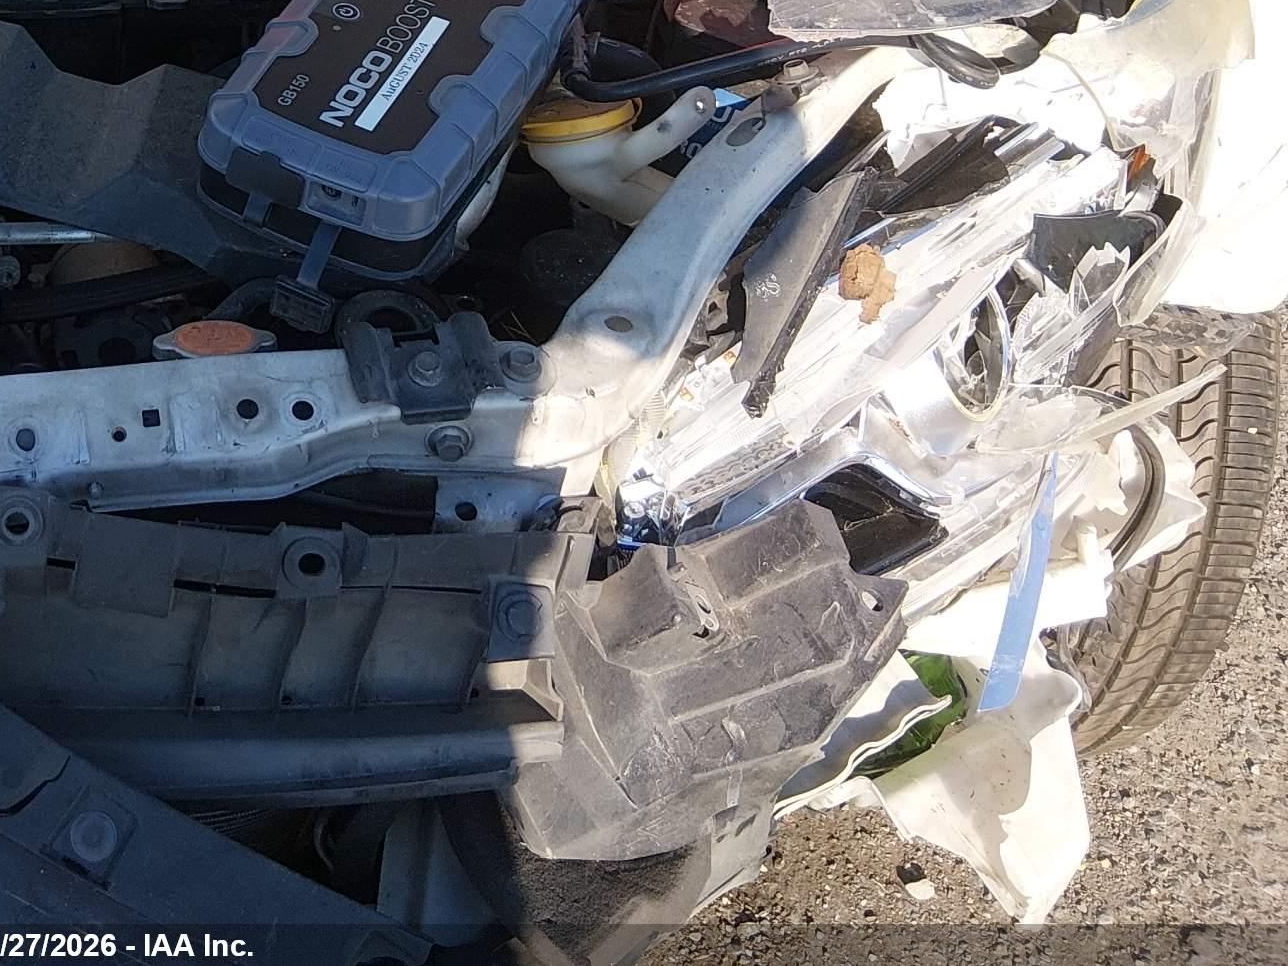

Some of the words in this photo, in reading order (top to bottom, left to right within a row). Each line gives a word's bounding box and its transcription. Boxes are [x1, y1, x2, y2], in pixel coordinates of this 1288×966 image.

[407, 42, 428, 64] 2024
[277, 74, 310, 105] GB150
[319, 50, 393, 128] NOCO
